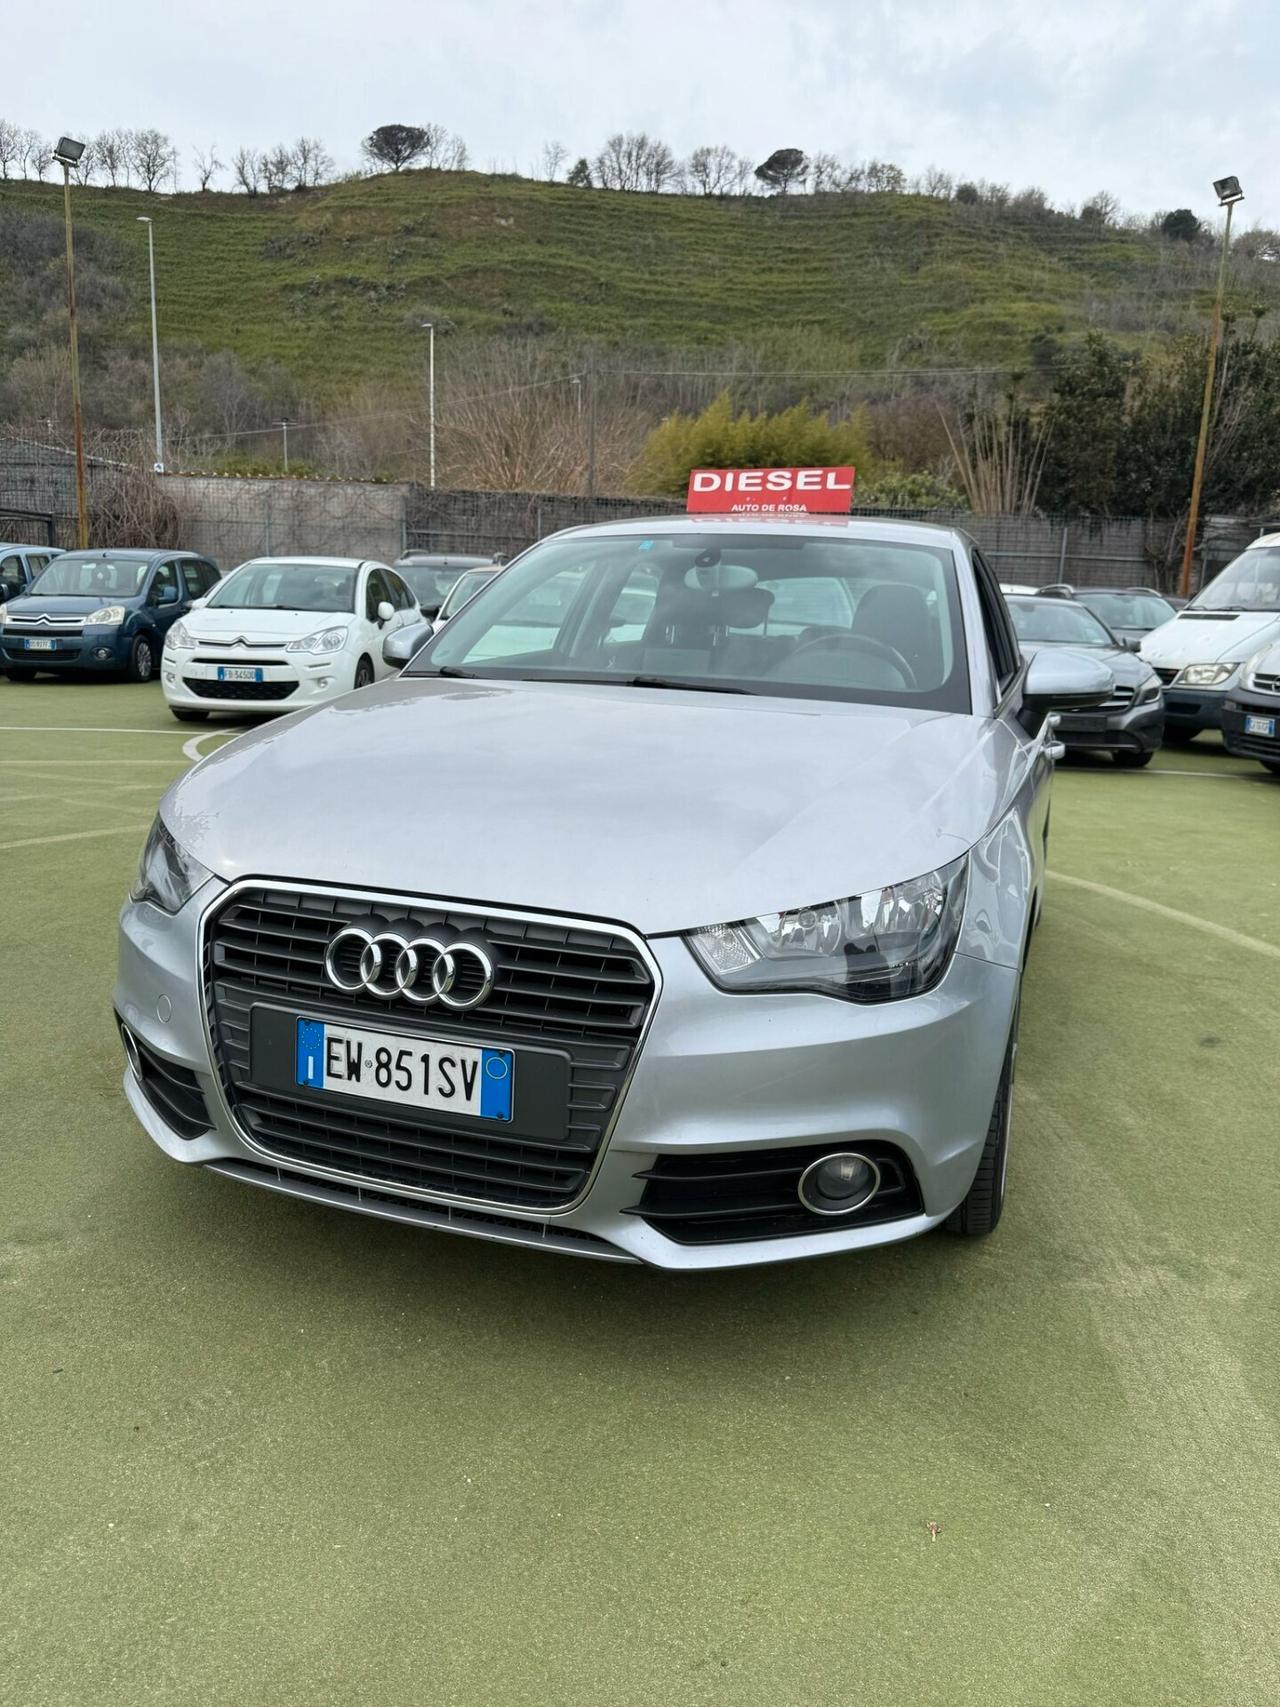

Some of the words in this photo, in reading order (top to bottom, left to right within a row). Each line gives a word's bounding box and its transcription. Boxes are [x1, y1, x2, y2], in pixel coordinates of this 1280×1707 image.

[693, 470, 851, 492] DIESEL
[731, 504, 760, 512] AUTO
[761, 504, 775, 512] DE
[777, 504, 807, 512] ROSA
